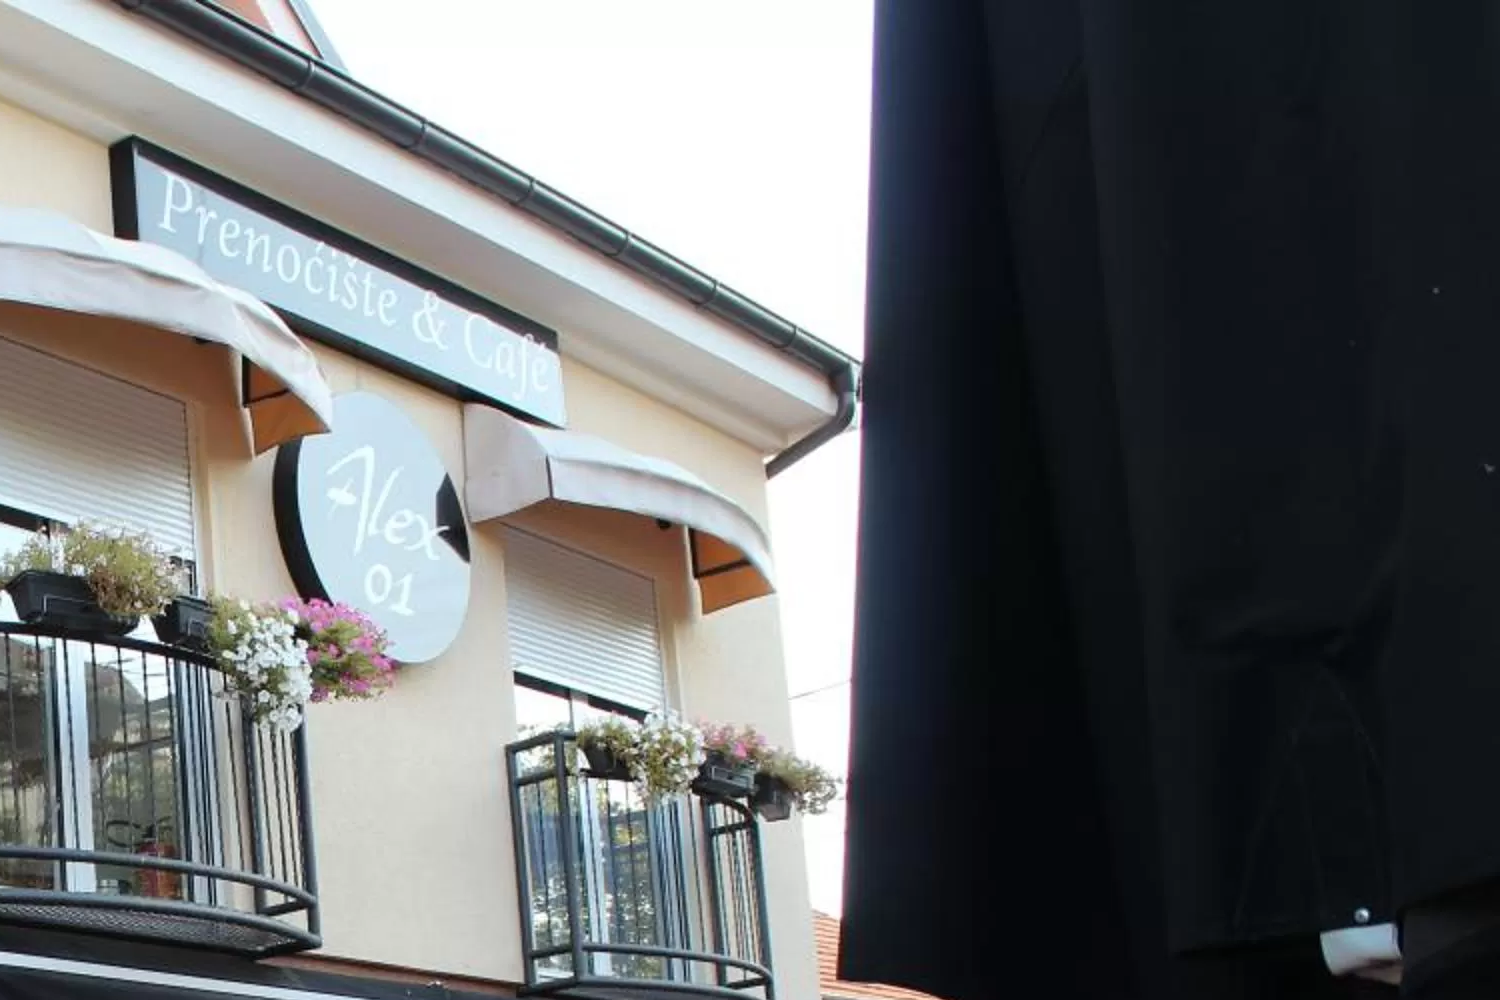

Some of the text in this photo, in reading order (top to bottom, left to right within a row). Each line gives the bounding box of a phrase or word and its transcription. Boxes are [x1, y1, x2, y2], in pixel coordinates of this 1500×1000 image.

[158, 174, 398, 326] Prenoćište
[412, 289, 449, 351] &
[326, 444, 451, 561] Alex
[363, 563, 415, 616] 01
